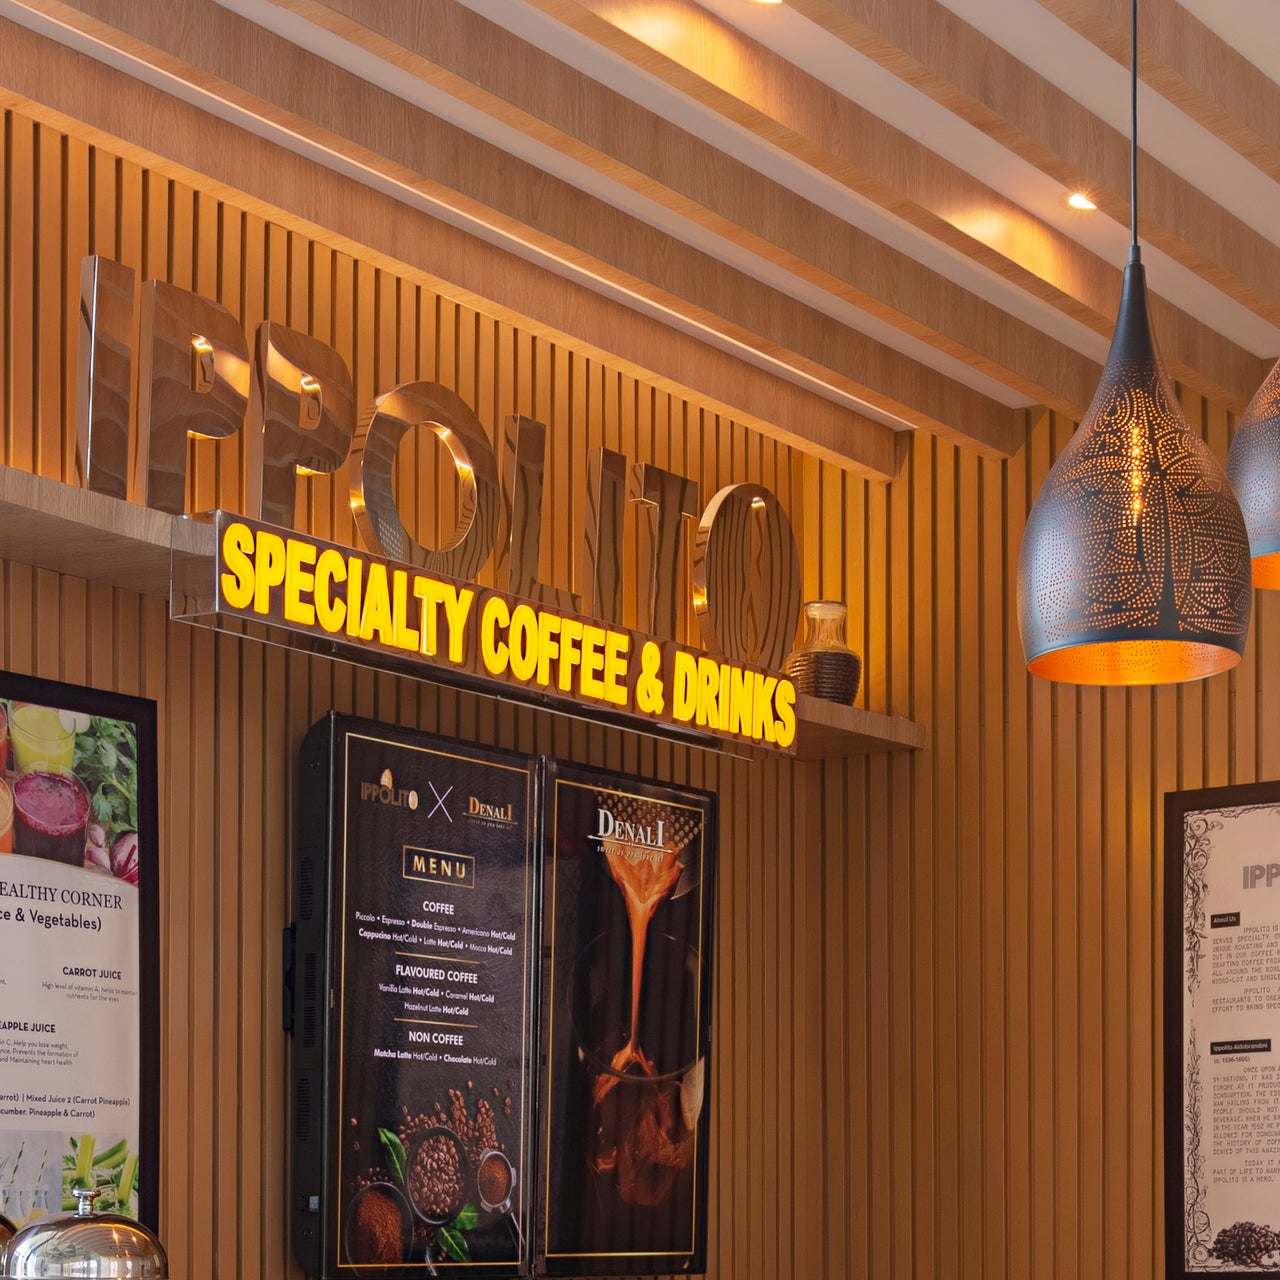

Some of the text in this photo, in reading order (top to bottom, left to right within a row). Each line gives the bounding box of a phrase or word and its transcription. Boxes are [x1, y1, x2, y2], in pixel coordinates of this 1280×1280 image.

[74, 254, 803, 672] IPPOLITO
[220, 521, 797, 748] SPECIALTY COFFEE & DRINKS
[361, 782, 418, 810] IPPOLITO
[413, 855, 466, 879] MENU
[60, 889, 121, 909] CORNER
[423, 900, 455, 915] COFFEE
[14, 907, 25, 921] &
[29, 909, 102, 933] Vegetables)
[355, 911, 374, 921] Piccolo
[381, 914, 404, 927] Espresso
[411, 919, 432, 929] Double
[433, 921, 456, 933] Espresso
[490, 930, 515, 941] Hot/Cold
[392, 932, 417, 943] Hot/Cold
[423, 936, 436, 945] Latte
[437, 938, 463, 949] Hot/Cold
[487, 944, 512, 955] Hot/Cold
[62, 966, 121, 979] CARROT JUICE
[395, 964, 477, 983] FLAVOURED COFFEE
[378, 983, 494, 1003] Vanilla Latte Hot/Cold Caramel Hot/Cold
[404, 1001, 468, 1015] Hazelnut Latte Hot/Cold
[32, 1023, 55, 1032] JUICE
[408, 1030, 463, 1045] NON COFFEE
[373, 1048, 496, 1065] Matcha Latte Hot/Cold Chocolate Hot/Cold
[25, 1094, 46, 1102] Mixed
[72, 1095, 97, 1104] (Carrot
[98, 1096, 130, 1106] Pineapple)
[28, 1107, 62, 1117] Pineapple
[70, 1109, 95, 1117] Carrot)
